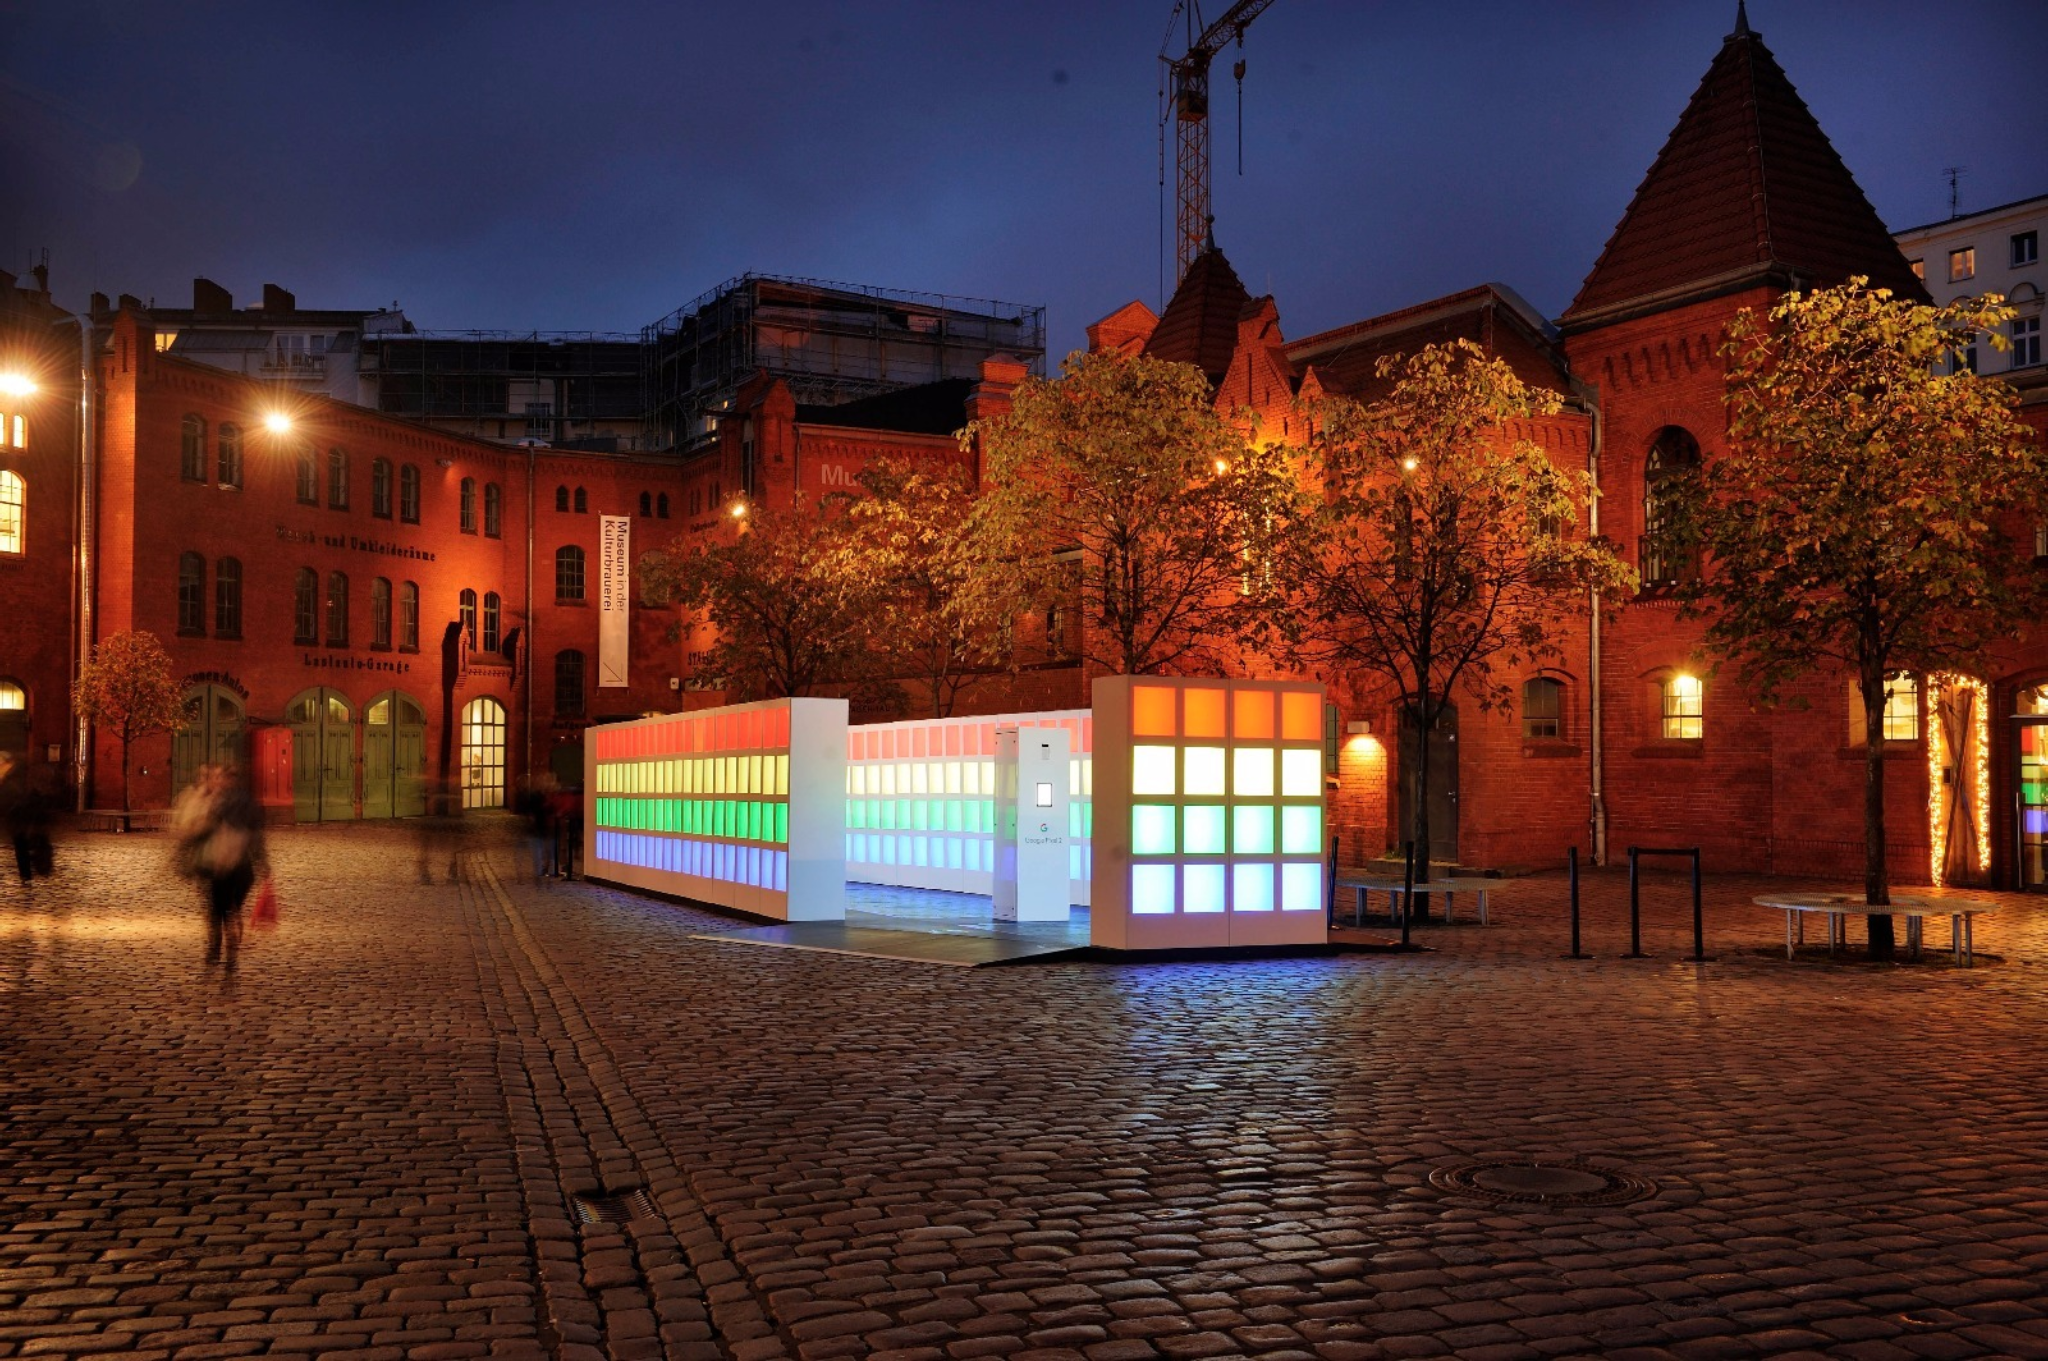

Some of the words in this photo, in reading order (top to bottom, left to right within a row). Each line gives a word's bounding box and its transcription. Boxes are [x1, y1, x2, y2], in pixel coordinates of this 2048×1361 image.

[603, 520, 615, 611] Kulturbrauerei
[616, 521, 628, 576] Museum
[616, 580, 627, 591] in
[616, 593, 627, 613] der
